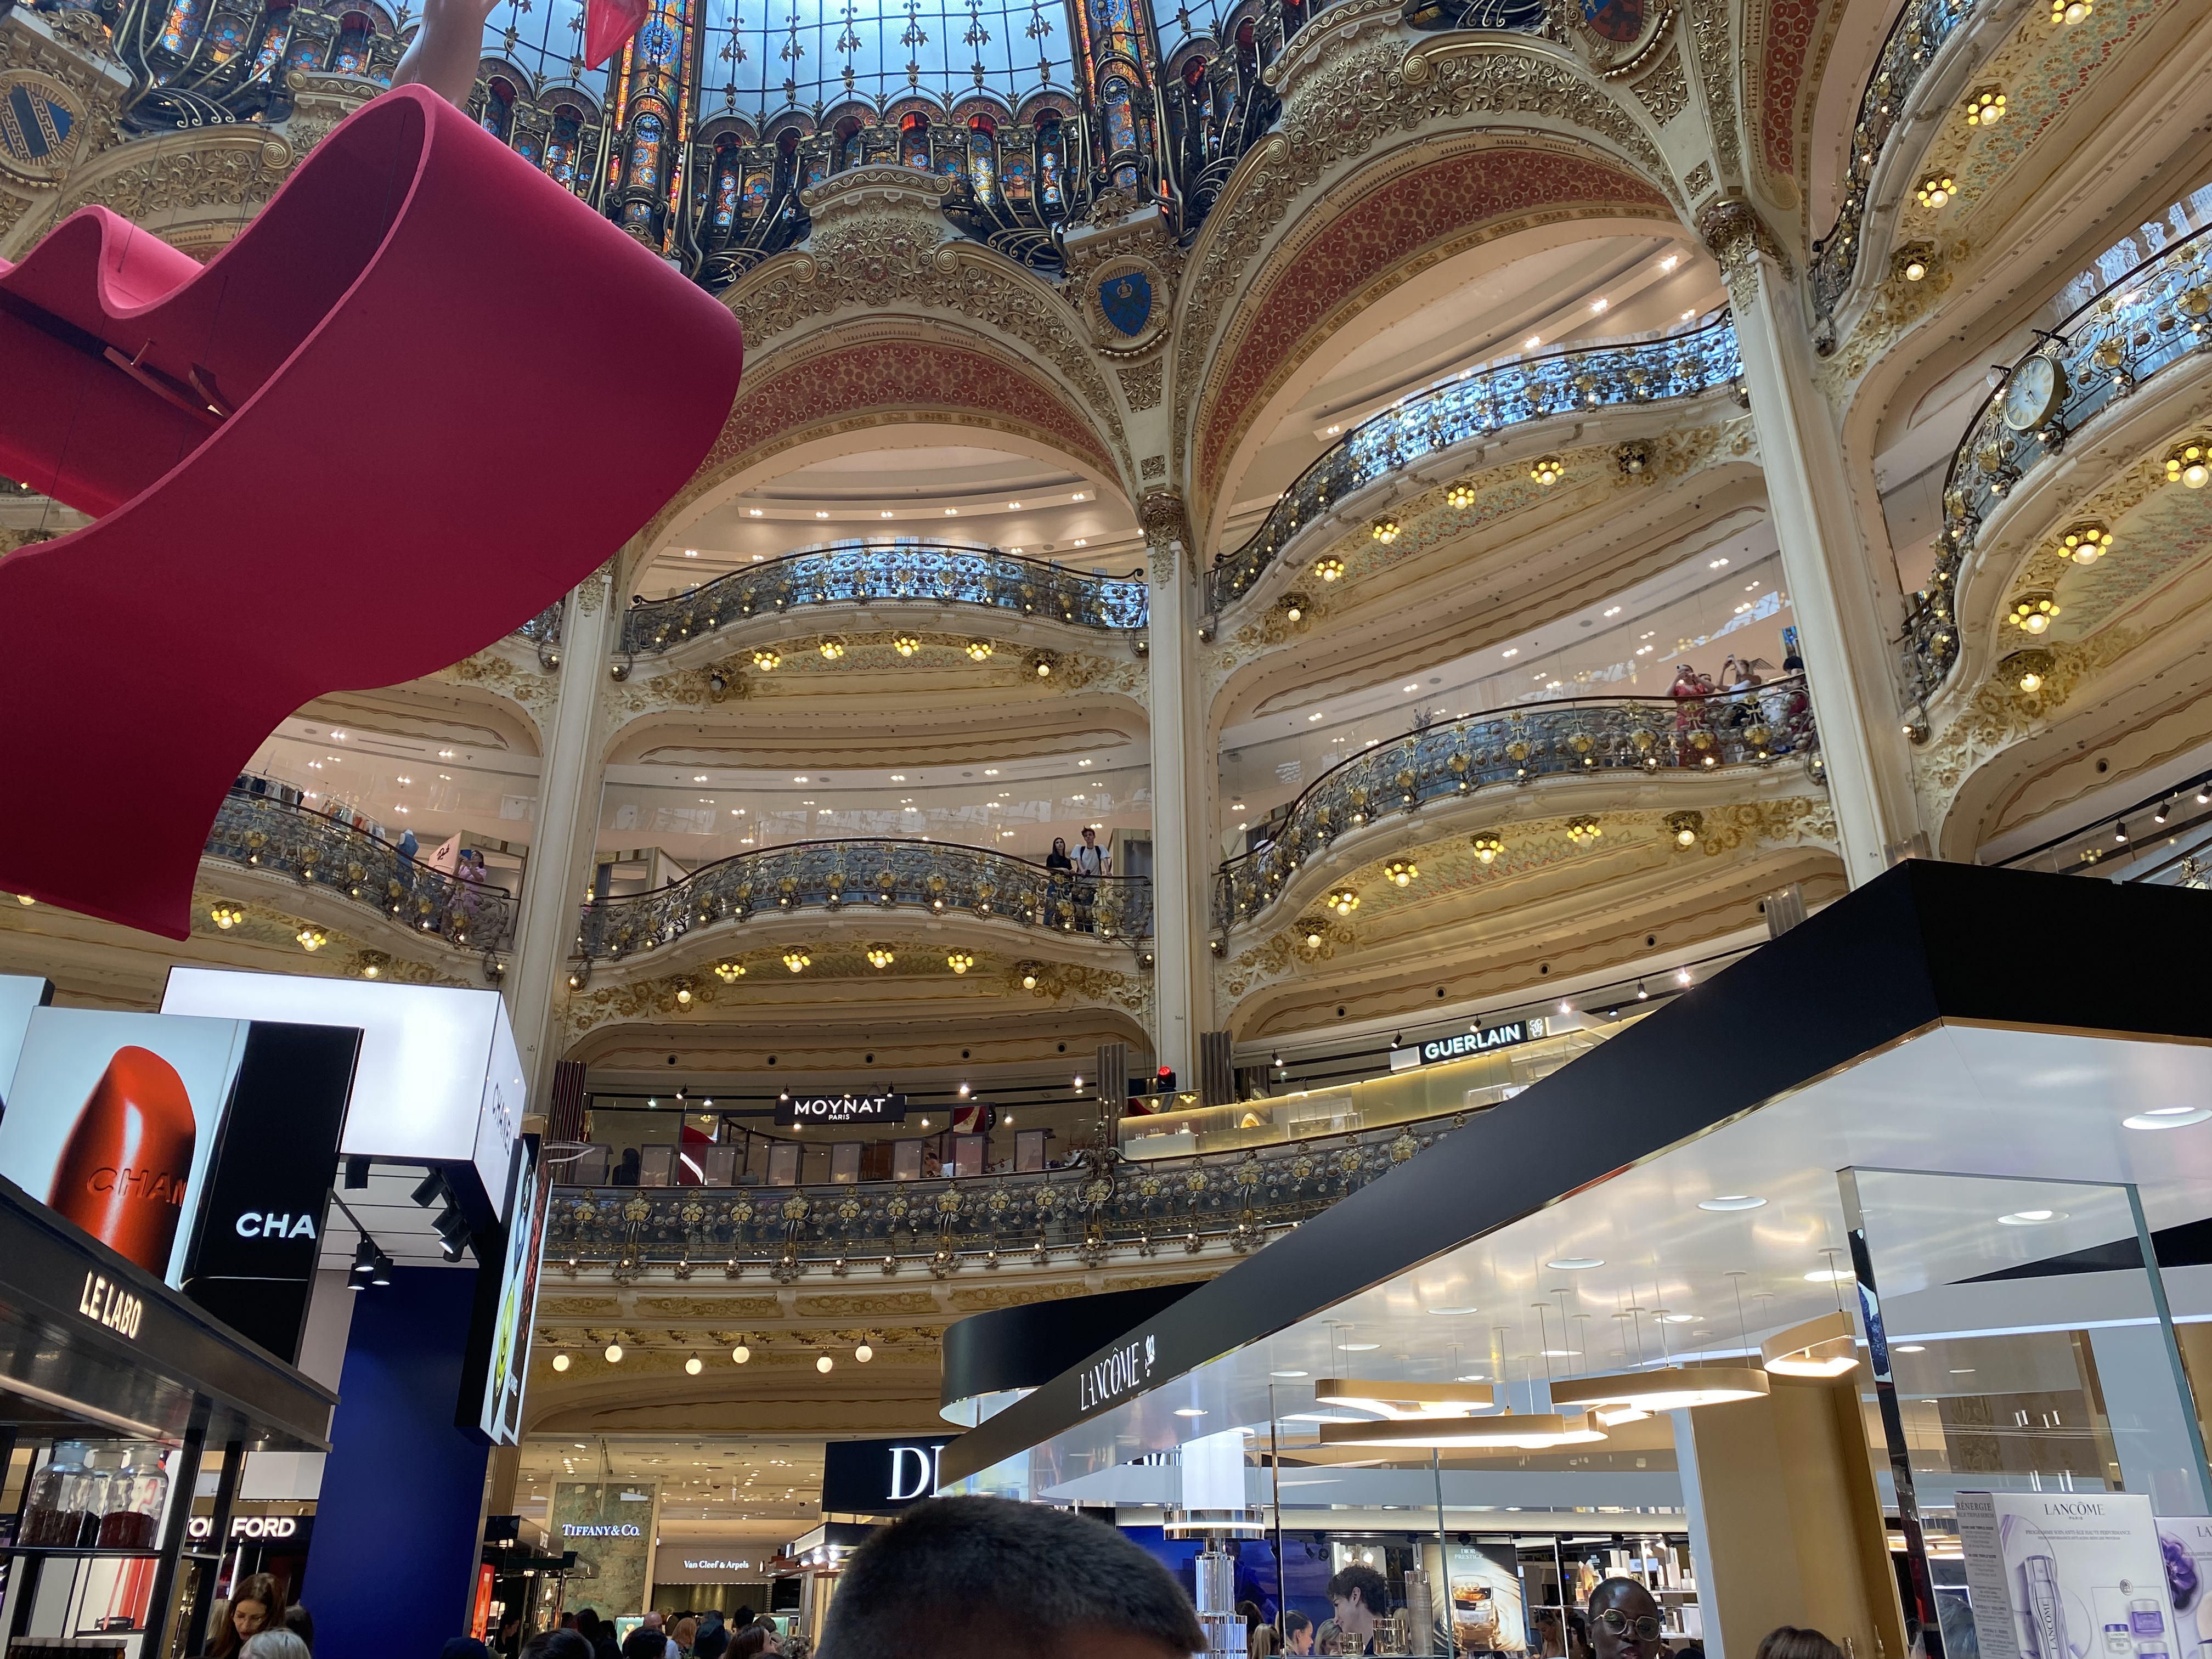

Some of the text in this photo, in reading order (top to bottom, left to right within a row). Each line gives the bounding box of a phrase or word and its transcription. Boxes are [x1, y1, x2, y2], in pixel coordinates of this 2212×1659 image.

[1425, 1024, 1520, 1059] GUERLAIN
[794, 1098, 885, 1115] MOYNAT
[492, 1082, 512, 1157] CHANEL
[236, 1212, 316, 1239] CHA
[78, 1270, 142, 1339] LE LABO
[1080, 1342, 1139, 1411] LANCÔME
[1956, 1500, 1992, 1511] RÉNERGIE
[2044, 1502, 2105, 1515] LANCÔME
[231, 1517, 295, 1537] FORD
[2197, 1526, 2212, 1537] LA
[684, 1560, 698, 1568] Van
[699, 1560, 719, 1568] Cleef
[726, 1560, 749, 1571] Arpels
